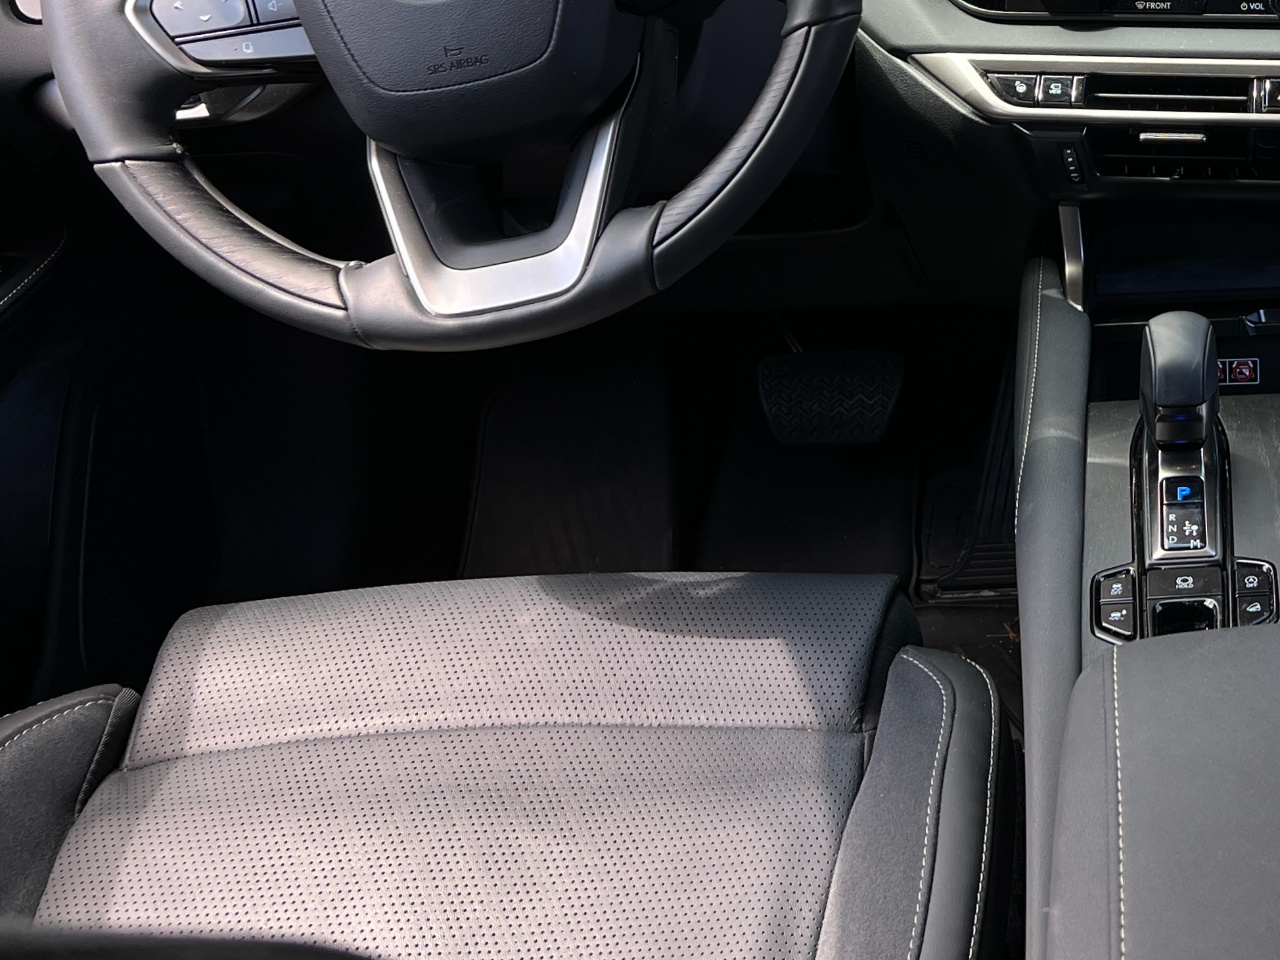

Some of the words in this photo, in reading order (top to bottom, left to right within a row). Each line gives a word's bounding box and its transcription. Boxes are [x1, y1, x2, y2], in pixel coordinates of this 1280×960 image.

[1147, 2, 1171, 10] FRONT
[427, 62, 447, 75] SRS
[449, 55, 490, 70] AIRBAG
[1177, 486, 1191, 501] P
[1169, 536, 1177, 544] D
[1190, 540, 1201, 548] M
